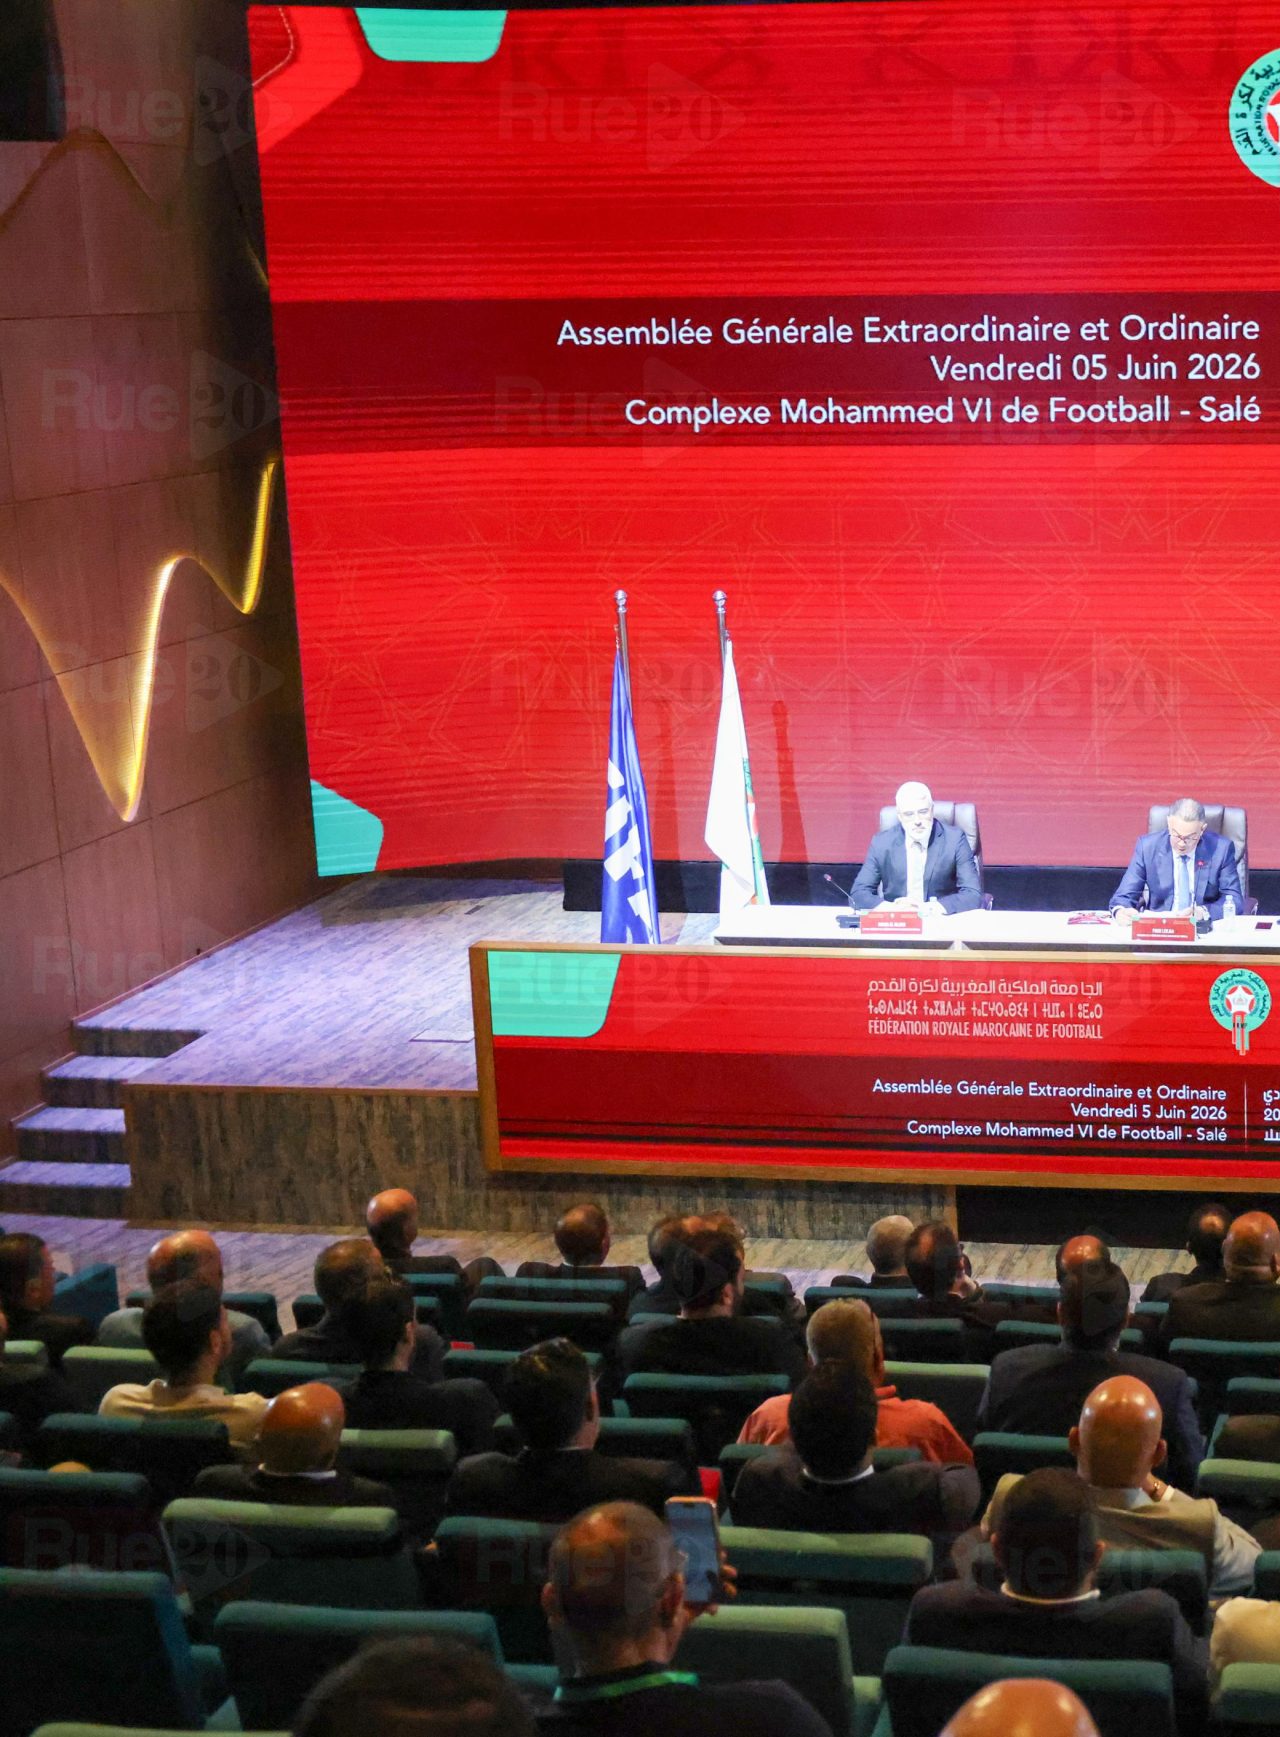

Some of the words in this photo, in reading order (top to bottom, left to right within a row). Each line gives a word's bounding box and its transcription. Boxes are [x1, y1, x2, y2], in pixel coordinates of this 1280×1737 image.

[557, 318, 712, 345] Assemblée
[723, 316, 853, 344] Générale
[864, 315, 1070, 342] Extraordinaire
[1080, 319, 1109, 340] et
[1121, 313, 1259, 340] Ordinaire
[930, 353, 1061, 381] Vendredi
[1073, 354, 1107, 380] 05
[1118, 354, 1176, 379] Juin
[1188, 353, 1260, 379] 2026
[626, 398, 771, 432] Complexe
[781, 397, 953, 423] Mohammed
[963, 398, 991, 422] VI
[1002, 397, 1039, 423] de
[1050, 396, 1169, 422] Football
[1200, 395, 1261, 422] Salé
[869, 1018, 929, 1035] FÉDÉRATION
[933, 1022, 969, 1036] ROYALE
[973, 1023, 1032, 1037] MAROCAINE
[1036, 1024, 1049, 1037] DE
[1053, 1024, 1103, 1038] FOOTBALL
[873, 1079, 952, 1094] Assemblée
[957, 1081, 1023, 1095] Générale
[1029, 1082, 1132, 1098] Extraordinaire
[1137, 1087, 1152, 1098] et
[1157, 1085, 1226, 1100] Ordinaire
[1071, 1103, 1137, 1117] Vendredi
[1142, 1105, 1151, 1118] 5
[1156, 1105, 1185, 1118] Juin
[1191, 1106, 1227, 1120] 2026
[908, 1120, 981, 1139] Complexe
[986, 1122, 1073, 1137] Mohammed
[1078, 1125, 1092, 1137] VI
[1098, 1124, 1116, 1138] de
[1122, 1126, 1181, 1140] Football
[1197, 1127, 1227, 1141] Salé
